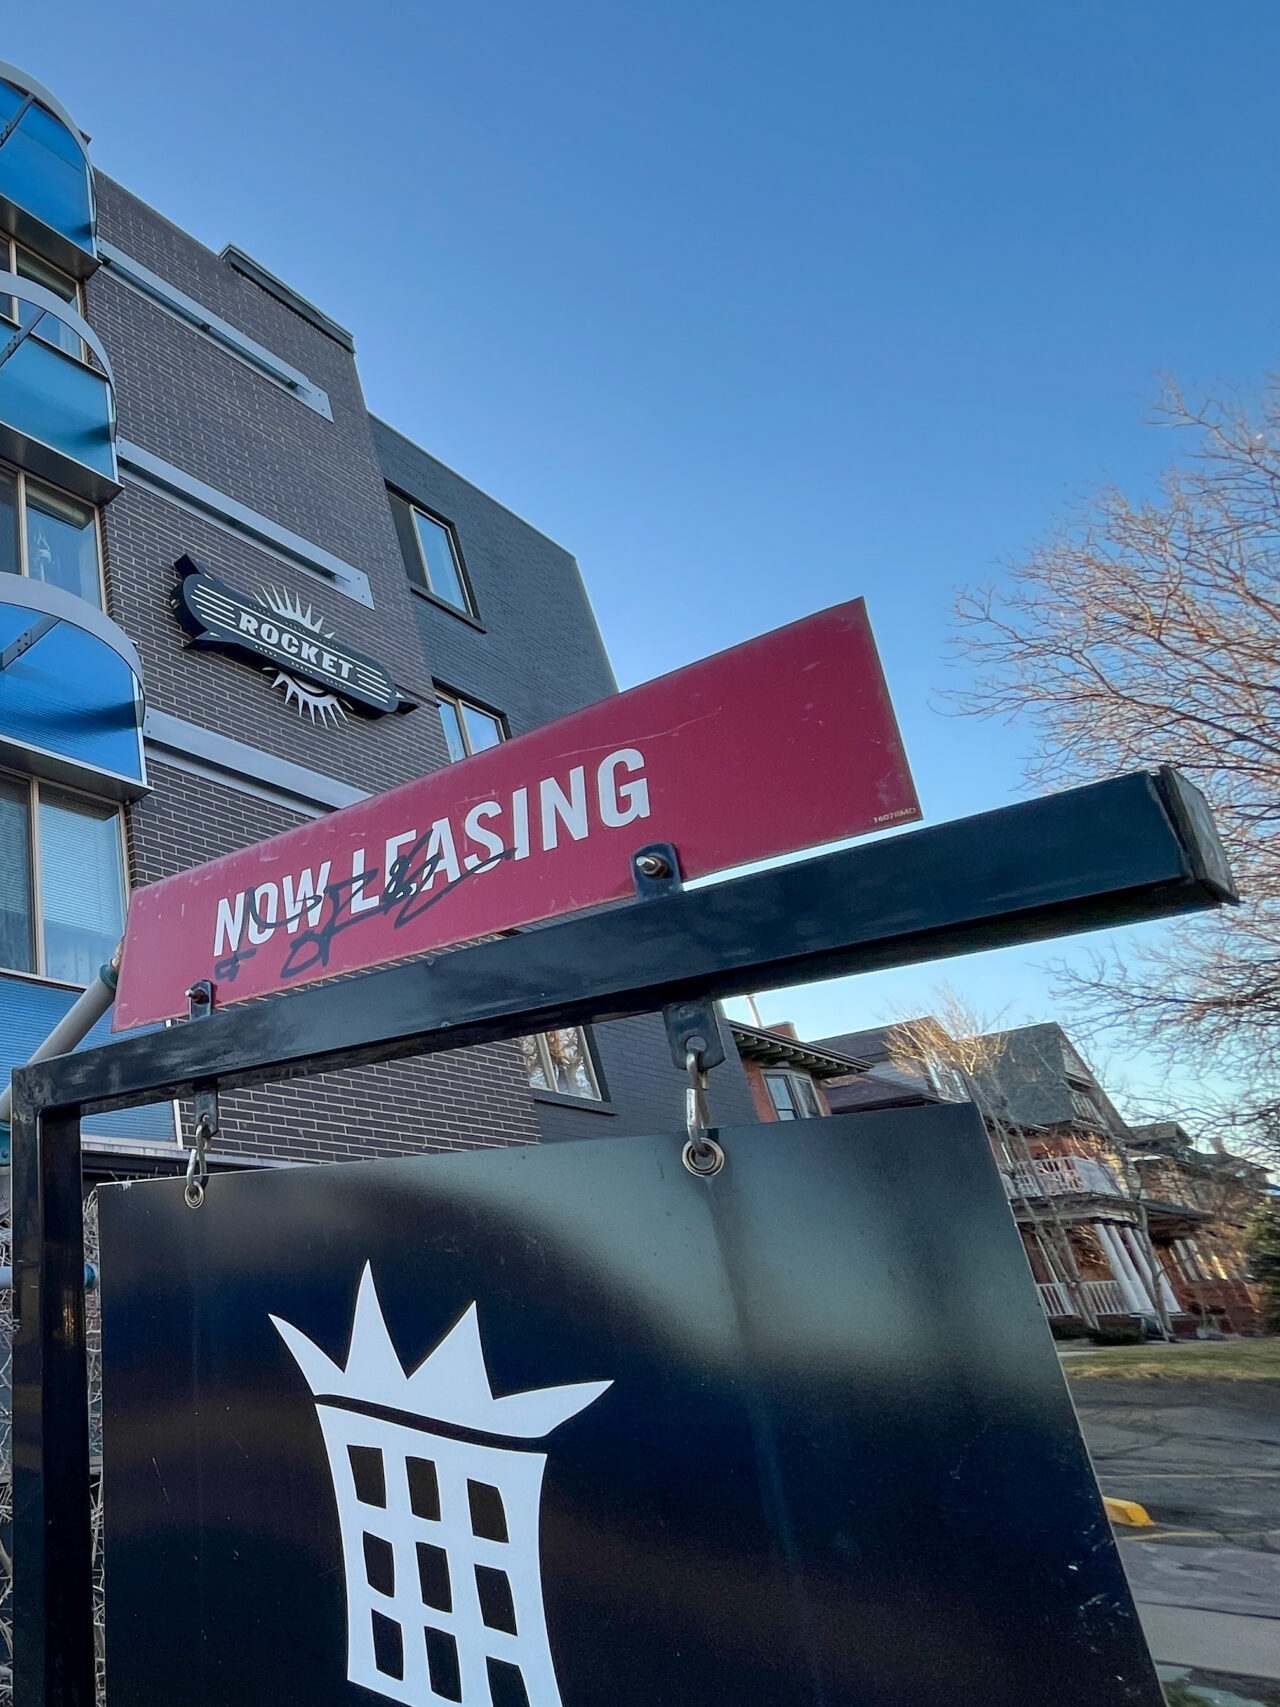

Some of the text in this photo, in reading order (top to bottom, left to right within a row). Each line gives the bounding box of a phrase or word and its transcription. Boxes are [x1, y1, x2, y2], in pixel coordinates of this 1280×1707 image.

[239, 611, 354, 679] ROCKET
[213, 860, 332, 957] NOW
[351, 748, 650, 914] LEASING
